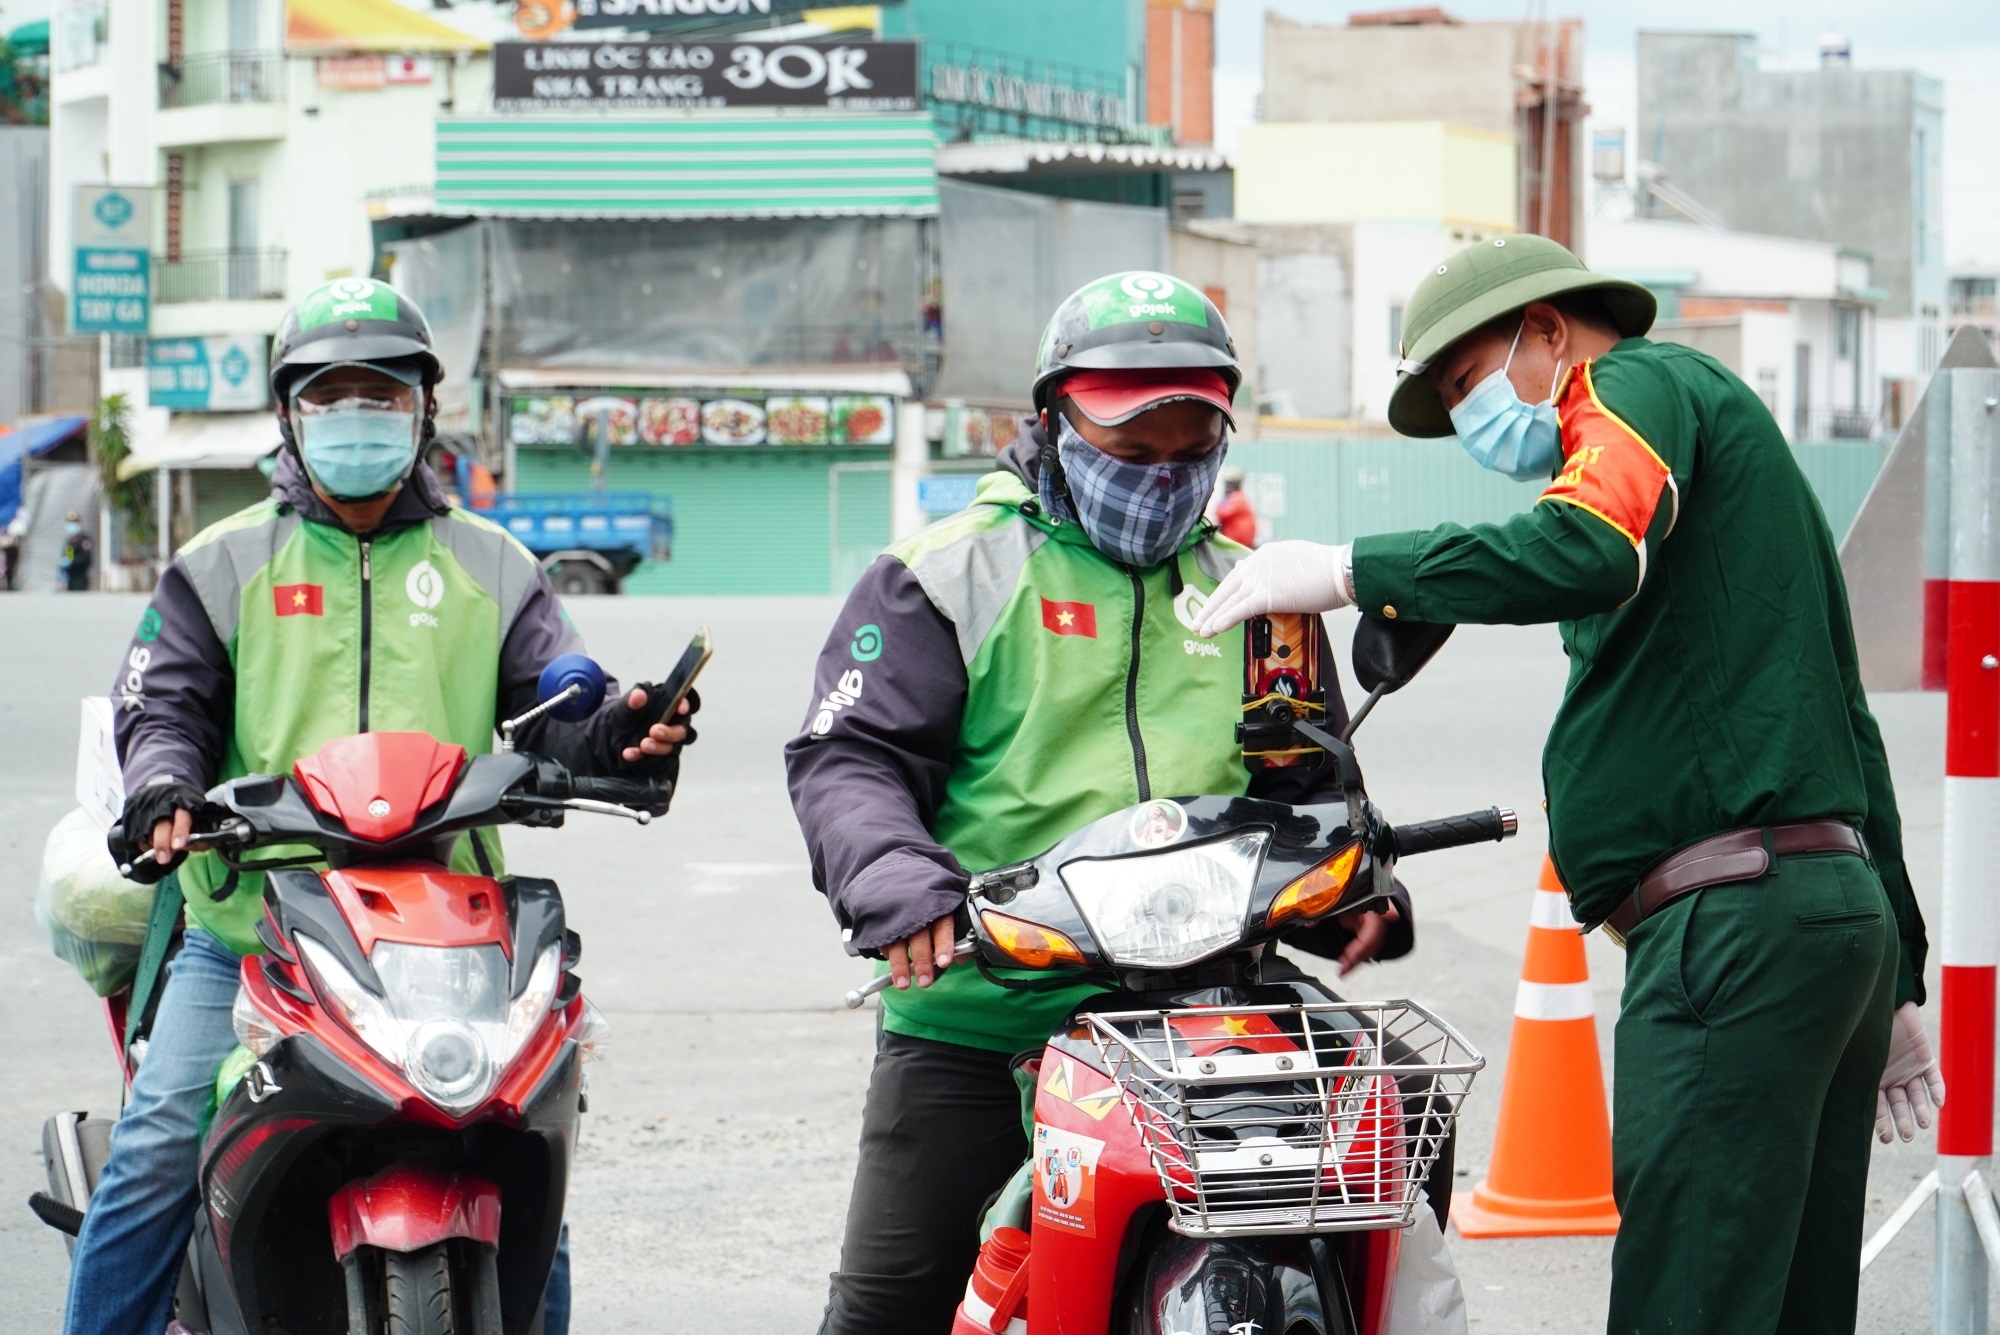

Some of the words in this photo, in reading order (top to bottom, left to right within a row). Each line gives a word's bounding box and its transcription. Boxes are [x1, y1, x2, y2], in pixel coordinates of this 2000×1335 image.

[721, 44, 874, 96] 30K
[532, 74, 594, 98] NHA
[597, 74, 704, 98] TRANG
[1129, 302, 1177, 318] gojek
[1183, 639, 1223, 658] gojek
[810, 669, 863, 740] goje
